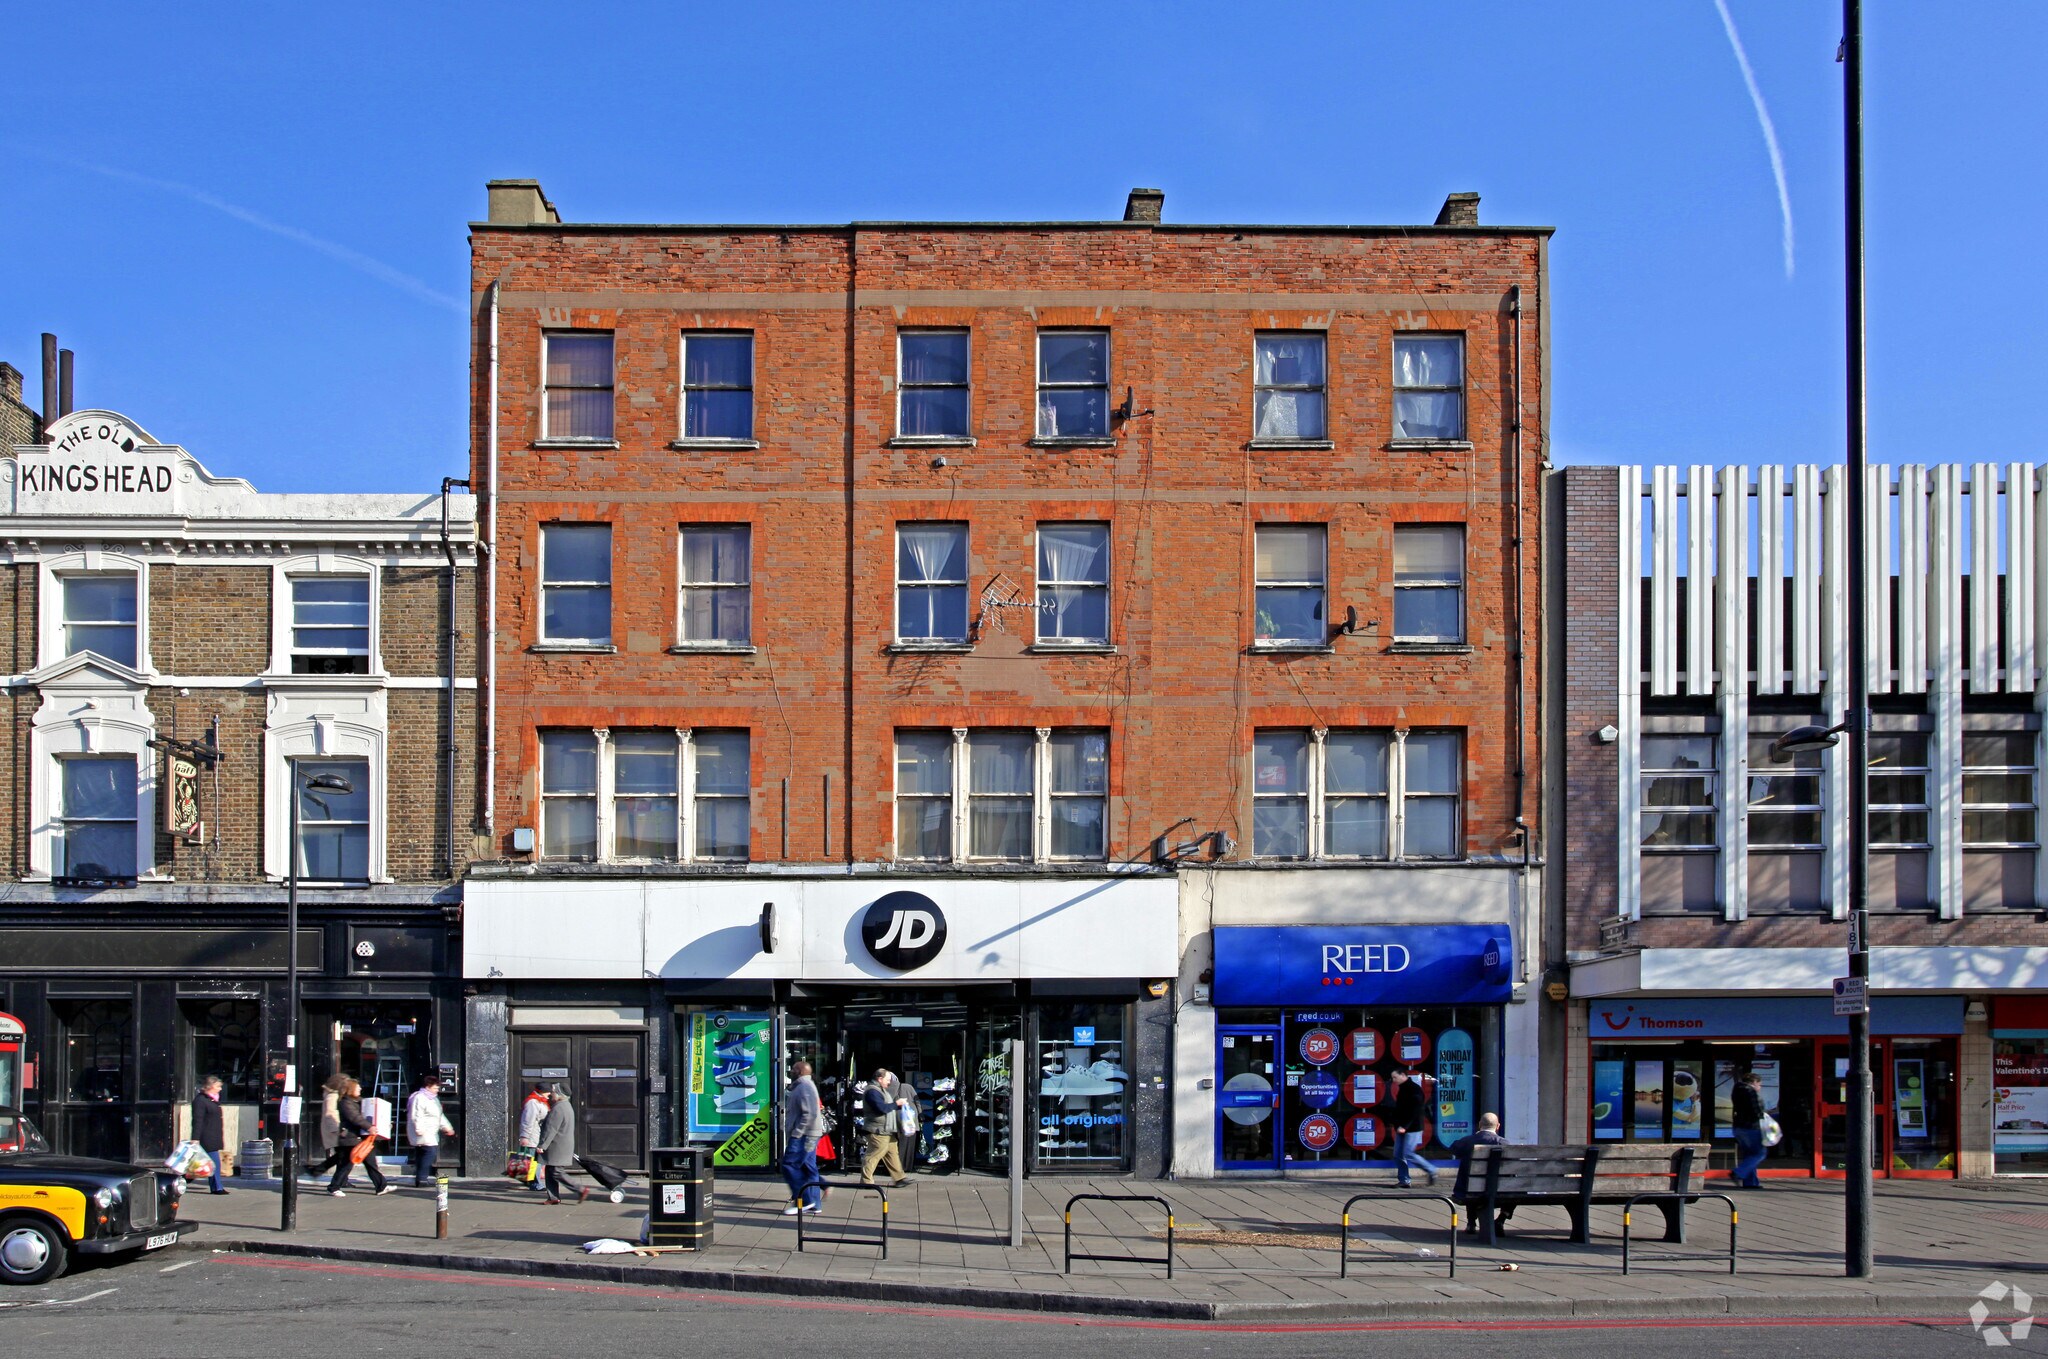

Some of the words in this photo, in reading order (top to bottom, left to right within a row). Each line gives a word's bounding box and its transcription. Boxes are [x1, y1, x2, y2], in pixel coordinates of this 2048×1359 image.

[57, 426, 92, 453] THE
[98, 425, 135, 453] OLD
[104, 466, 172, 492] HEAD
[875, 910, 936, 949] JD
[1848, 912, 1857, 952] 0187
[1322, 944, 1410, 973] REED
[1484, 951, 1498, 966] REED
[1298, 1012, 1340, 1020] reed.co.uk
[1639, 1017, 1703, 1028] Thomson
[1310, 1040, 1327, 1051] 50
[1440, 1050, 1471, 1062] MONDAY
[979, 1051, 1009, 1079] STREET
[1440, 1063, 1447, 1075] IS
[1450, 1063, 1464, 1075] THE
[1440, 1077, 1457, 1089] NEW
[1041, 1114, 1059, 1125] all
[720, 1117, 768, 1162] OFFERS
[1308, 1126, 1327, 1138] 50
[742, 1137, 765, 1159] CONTINUE
